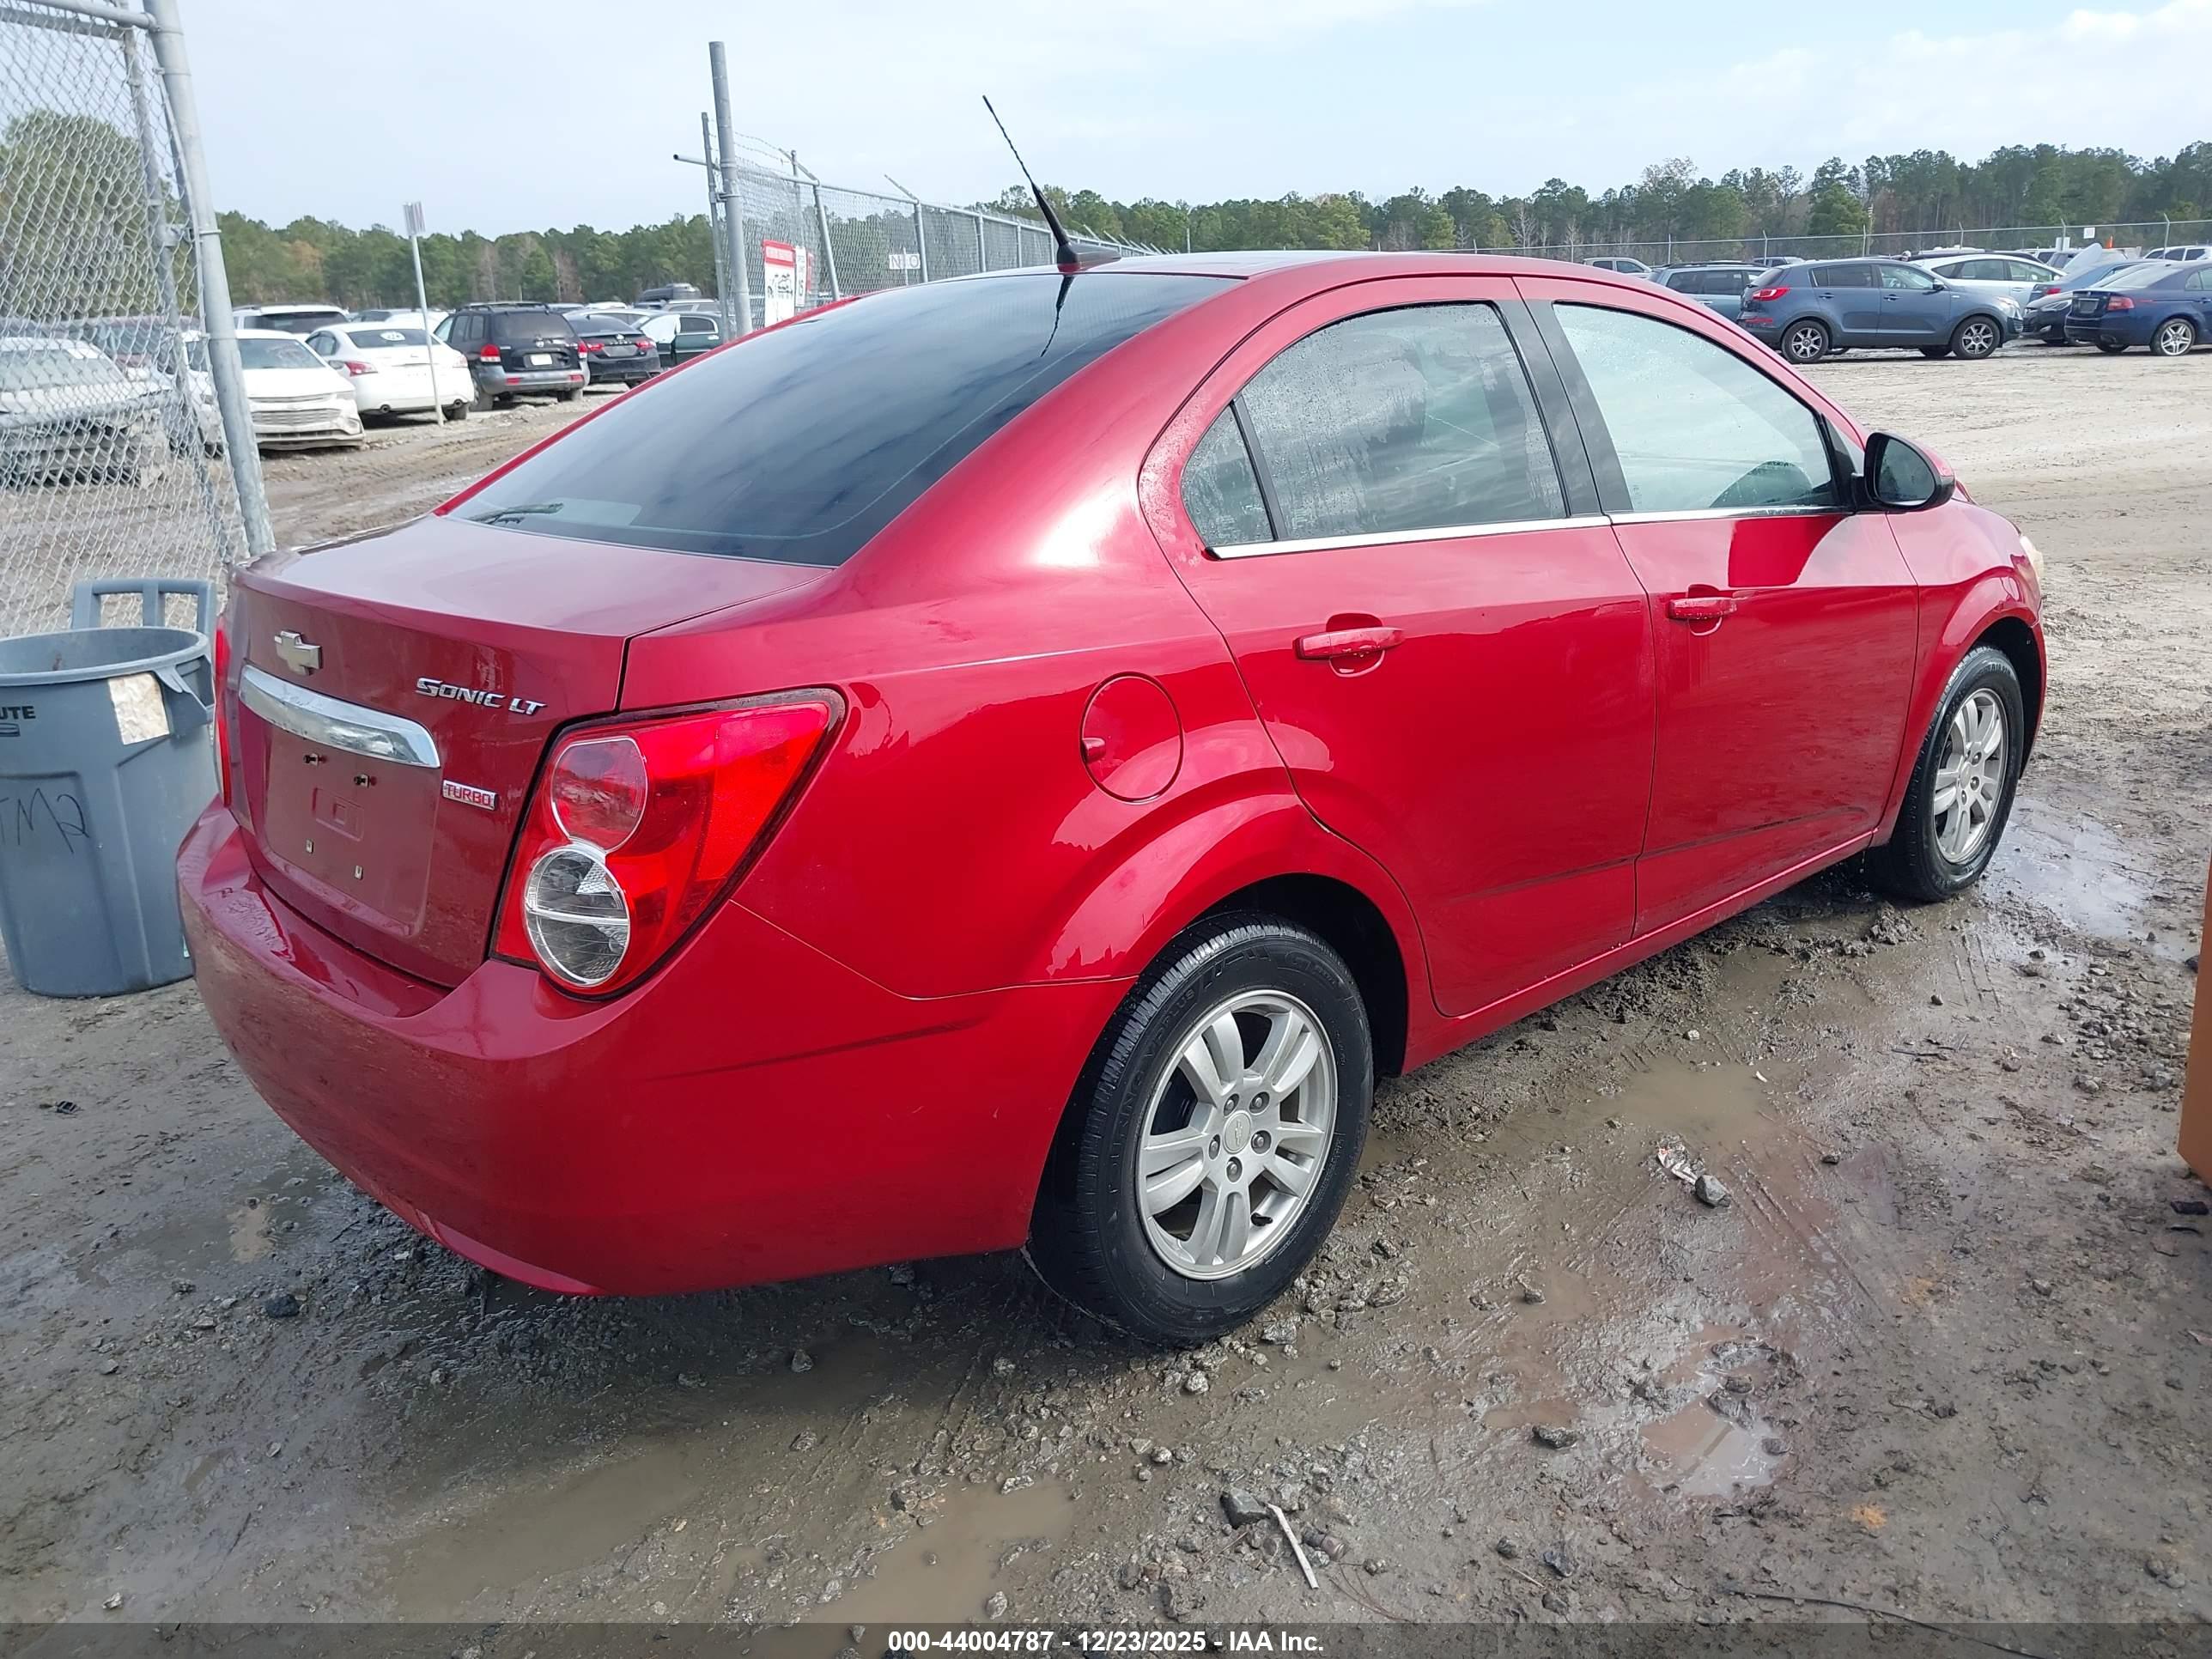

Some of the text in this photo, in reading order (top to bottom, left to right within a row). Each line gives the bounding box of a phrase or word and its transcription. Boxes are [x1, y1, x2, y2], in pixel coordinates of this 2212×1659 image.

[415, 677, 548, 716] SONIC LT
[444, 782, 493, 806] TURBO
